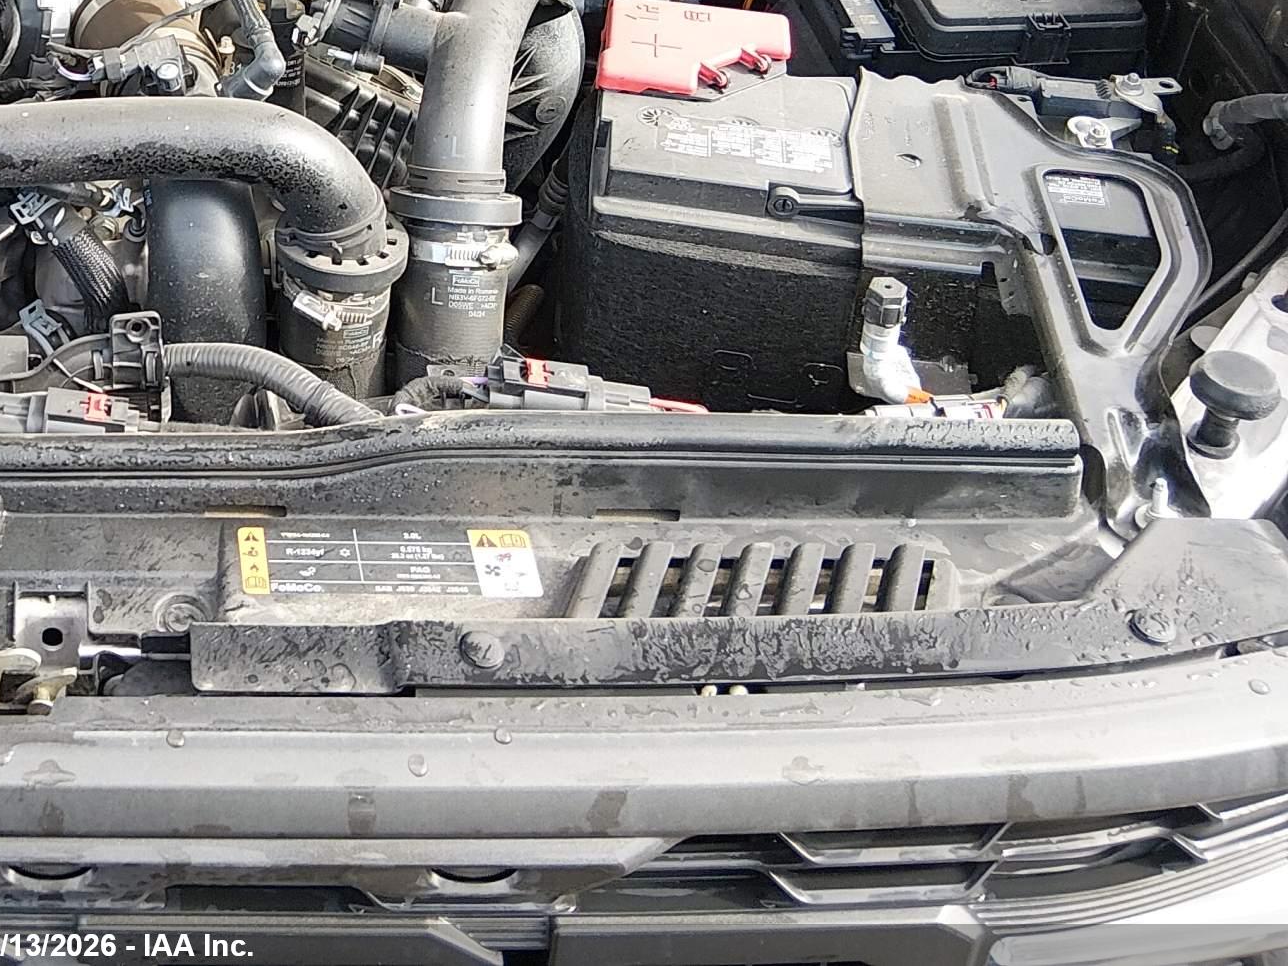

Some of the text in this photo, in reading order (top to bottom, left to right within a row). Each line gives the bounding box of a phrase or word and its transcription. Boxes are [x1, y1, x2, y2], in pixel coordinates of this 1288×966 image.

[448, 286, 466, 294] Made
[431, 286, 444, 306] L
[372, 330, 384, 349] R
[285, 546, 325, 557] R-1234yf
[410, 566, 432, 574] PAG
